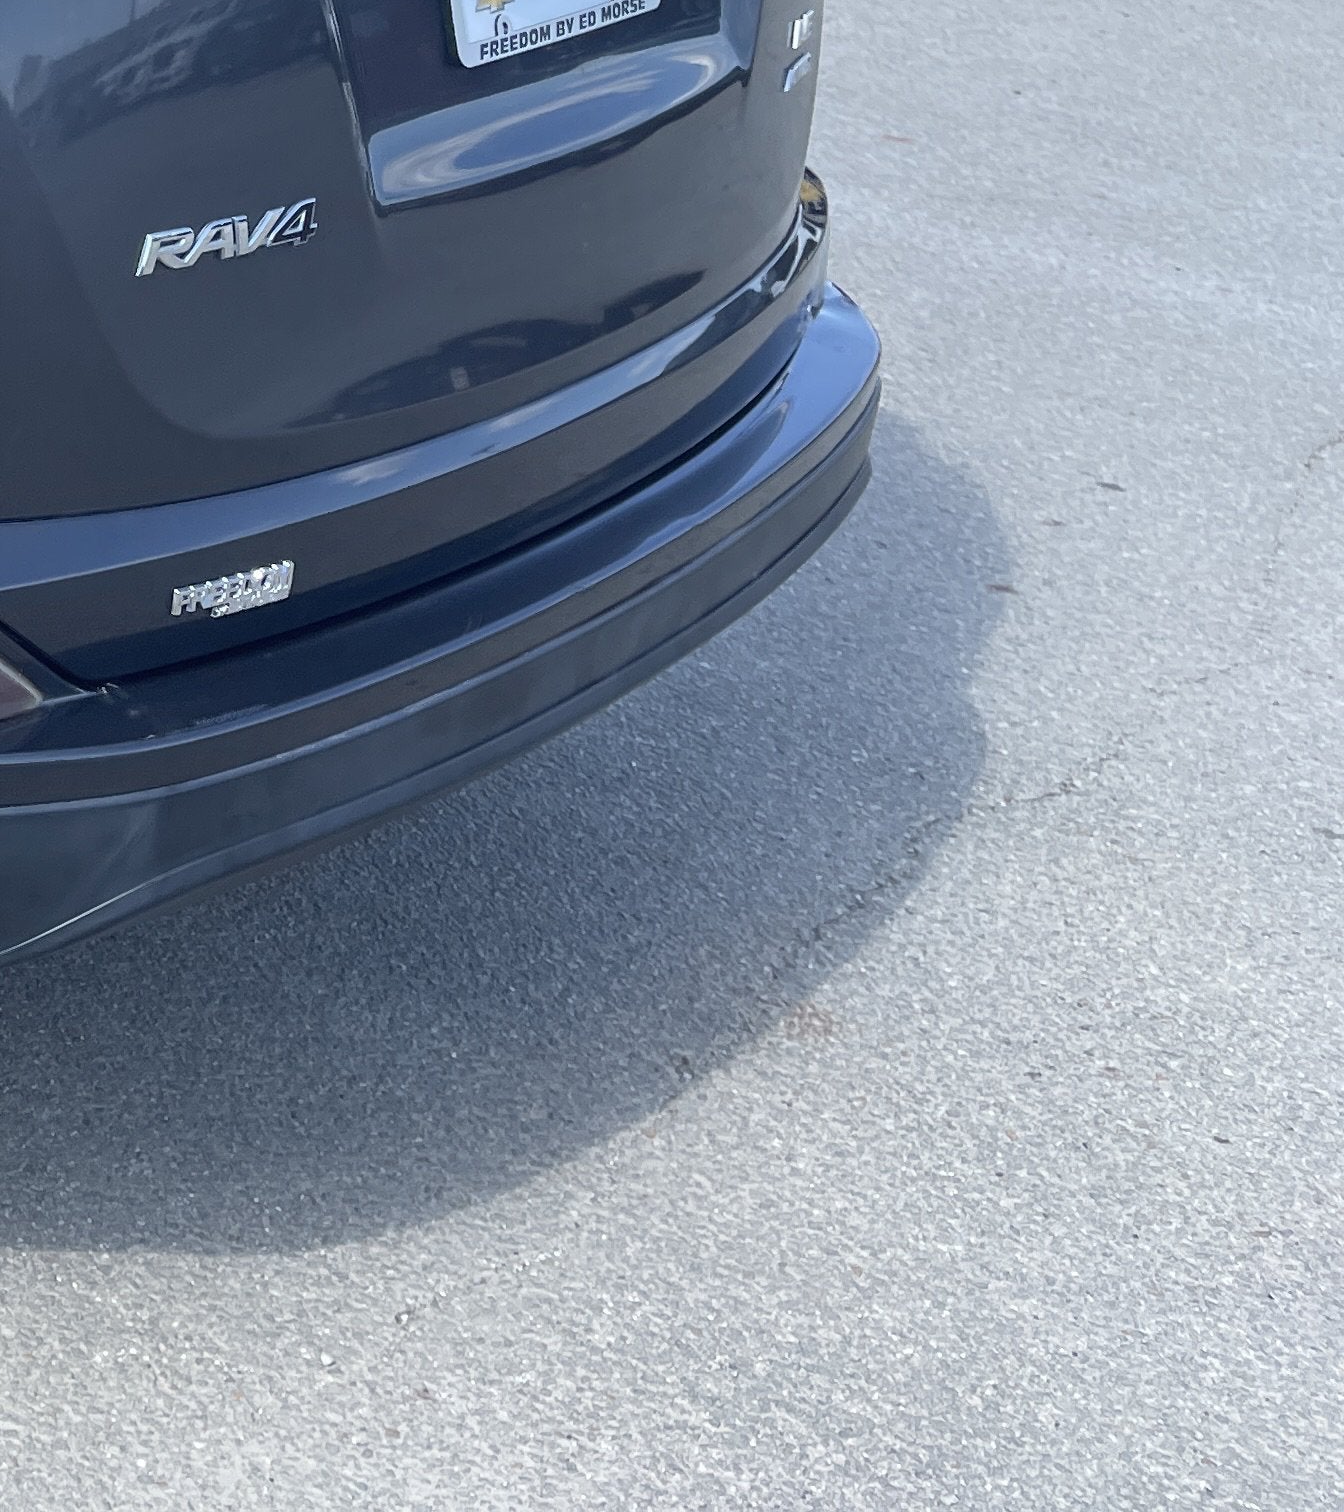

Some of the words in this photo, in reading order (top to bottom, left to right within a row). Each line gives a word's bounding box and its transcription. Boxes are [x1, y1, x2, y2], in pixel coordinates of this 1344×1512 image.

[479, 24, 551, 61] FREEDOM
[556, 17, 575, 38] BY
[579, 10, 597, 30] ED
[134, 197, 318, 278] RAV4
